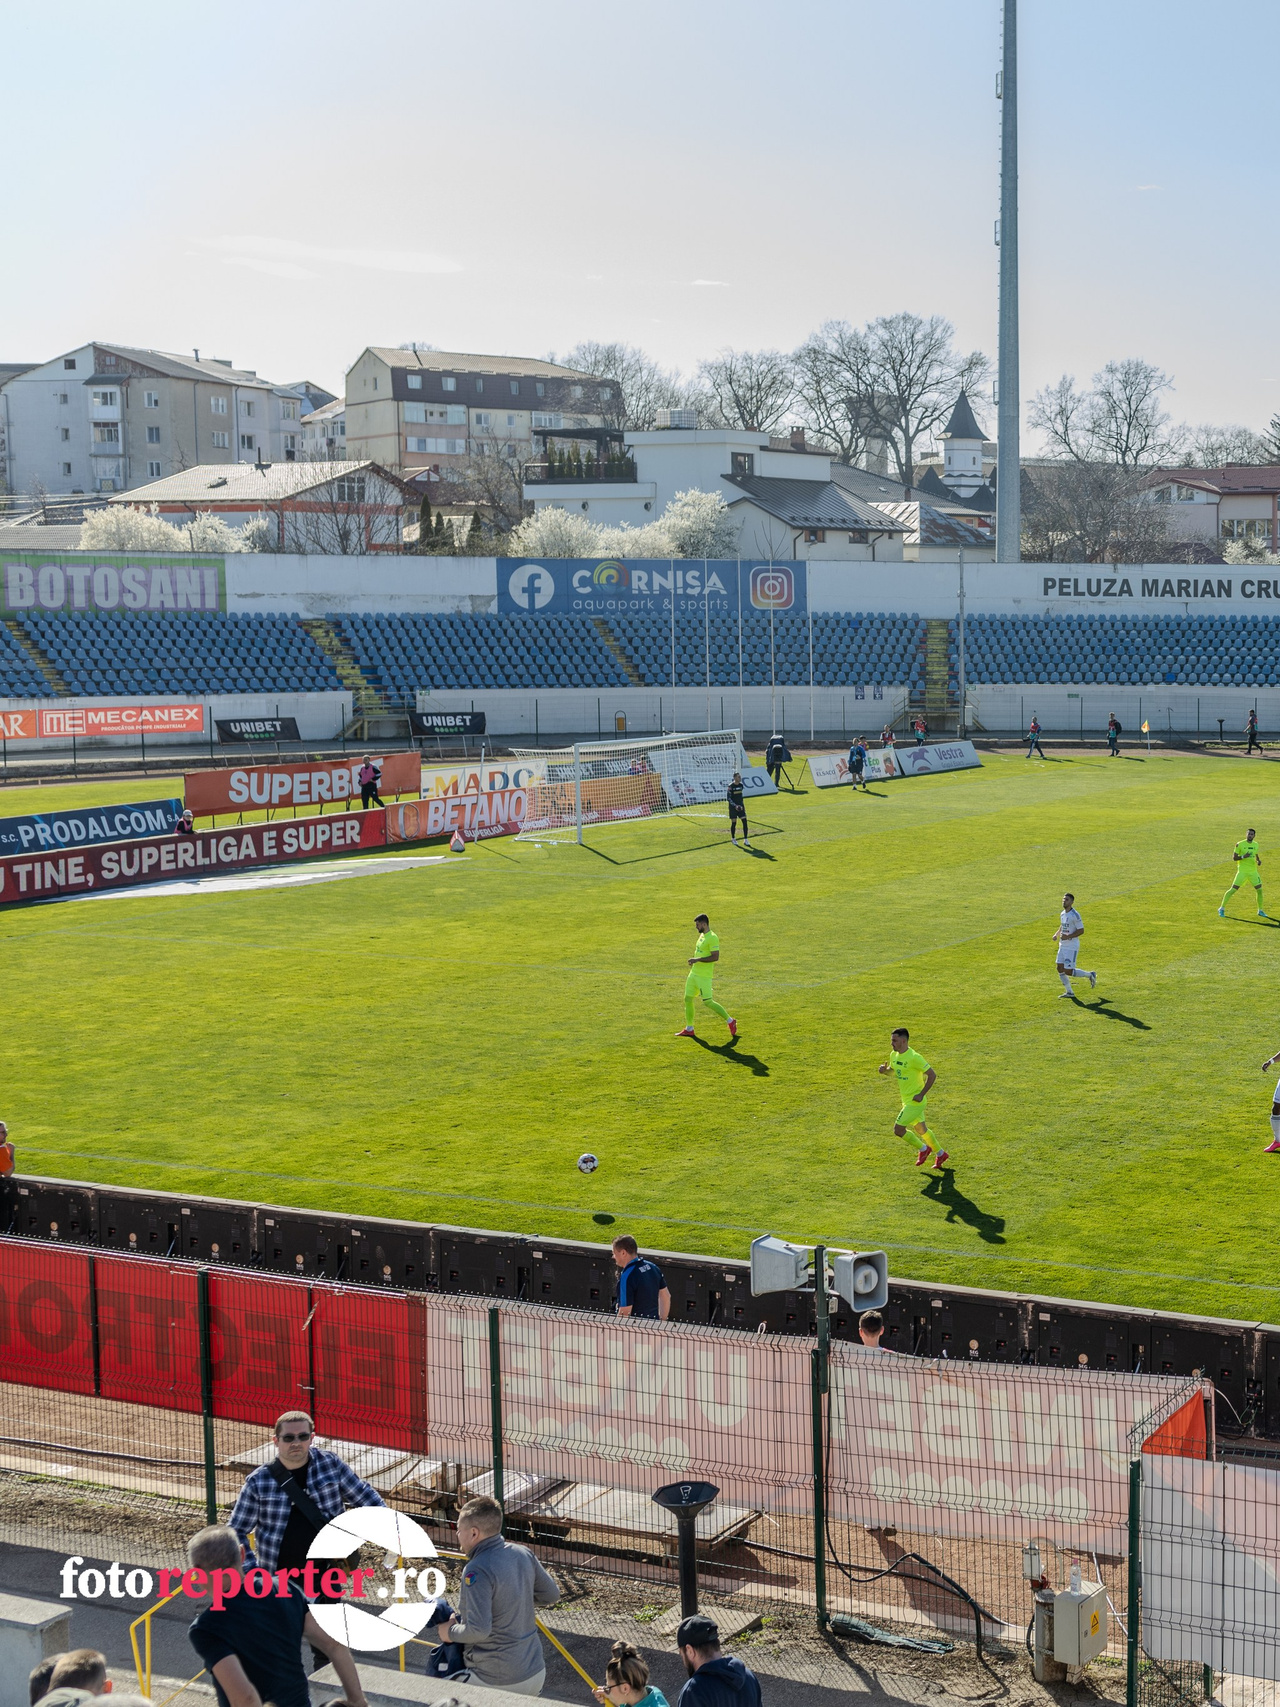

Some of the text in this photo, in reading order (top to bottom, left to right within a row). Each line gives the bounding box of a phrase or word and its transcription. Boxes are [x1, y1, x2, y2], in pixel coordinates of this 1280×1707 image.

[6, 565, 217, 609] BOTOSANI
[1043, 577, 1134, 598] PELUZA
[1141, 578, 1232, 599] MARIAN
[572, 599, 654, 612] aquapark
[88, 708, 199, 725] MECANEX
[422, 715, 472, 727] UNIBET
[230, 721, 282, 733] UNIBET
[934, 748, 965, 761] Vestra
[427, 790, 527, 836] BETANO
[1, 833, 19, 843] S.C.
[18, 808, 168, 848] PRODALCOM
[13, 855, 95, 893] TINE,
[101, 835, 257, 881] SUPERLIGA
[263, 830, 278, 857] E
[283, 819, 361, 854] SUPER
